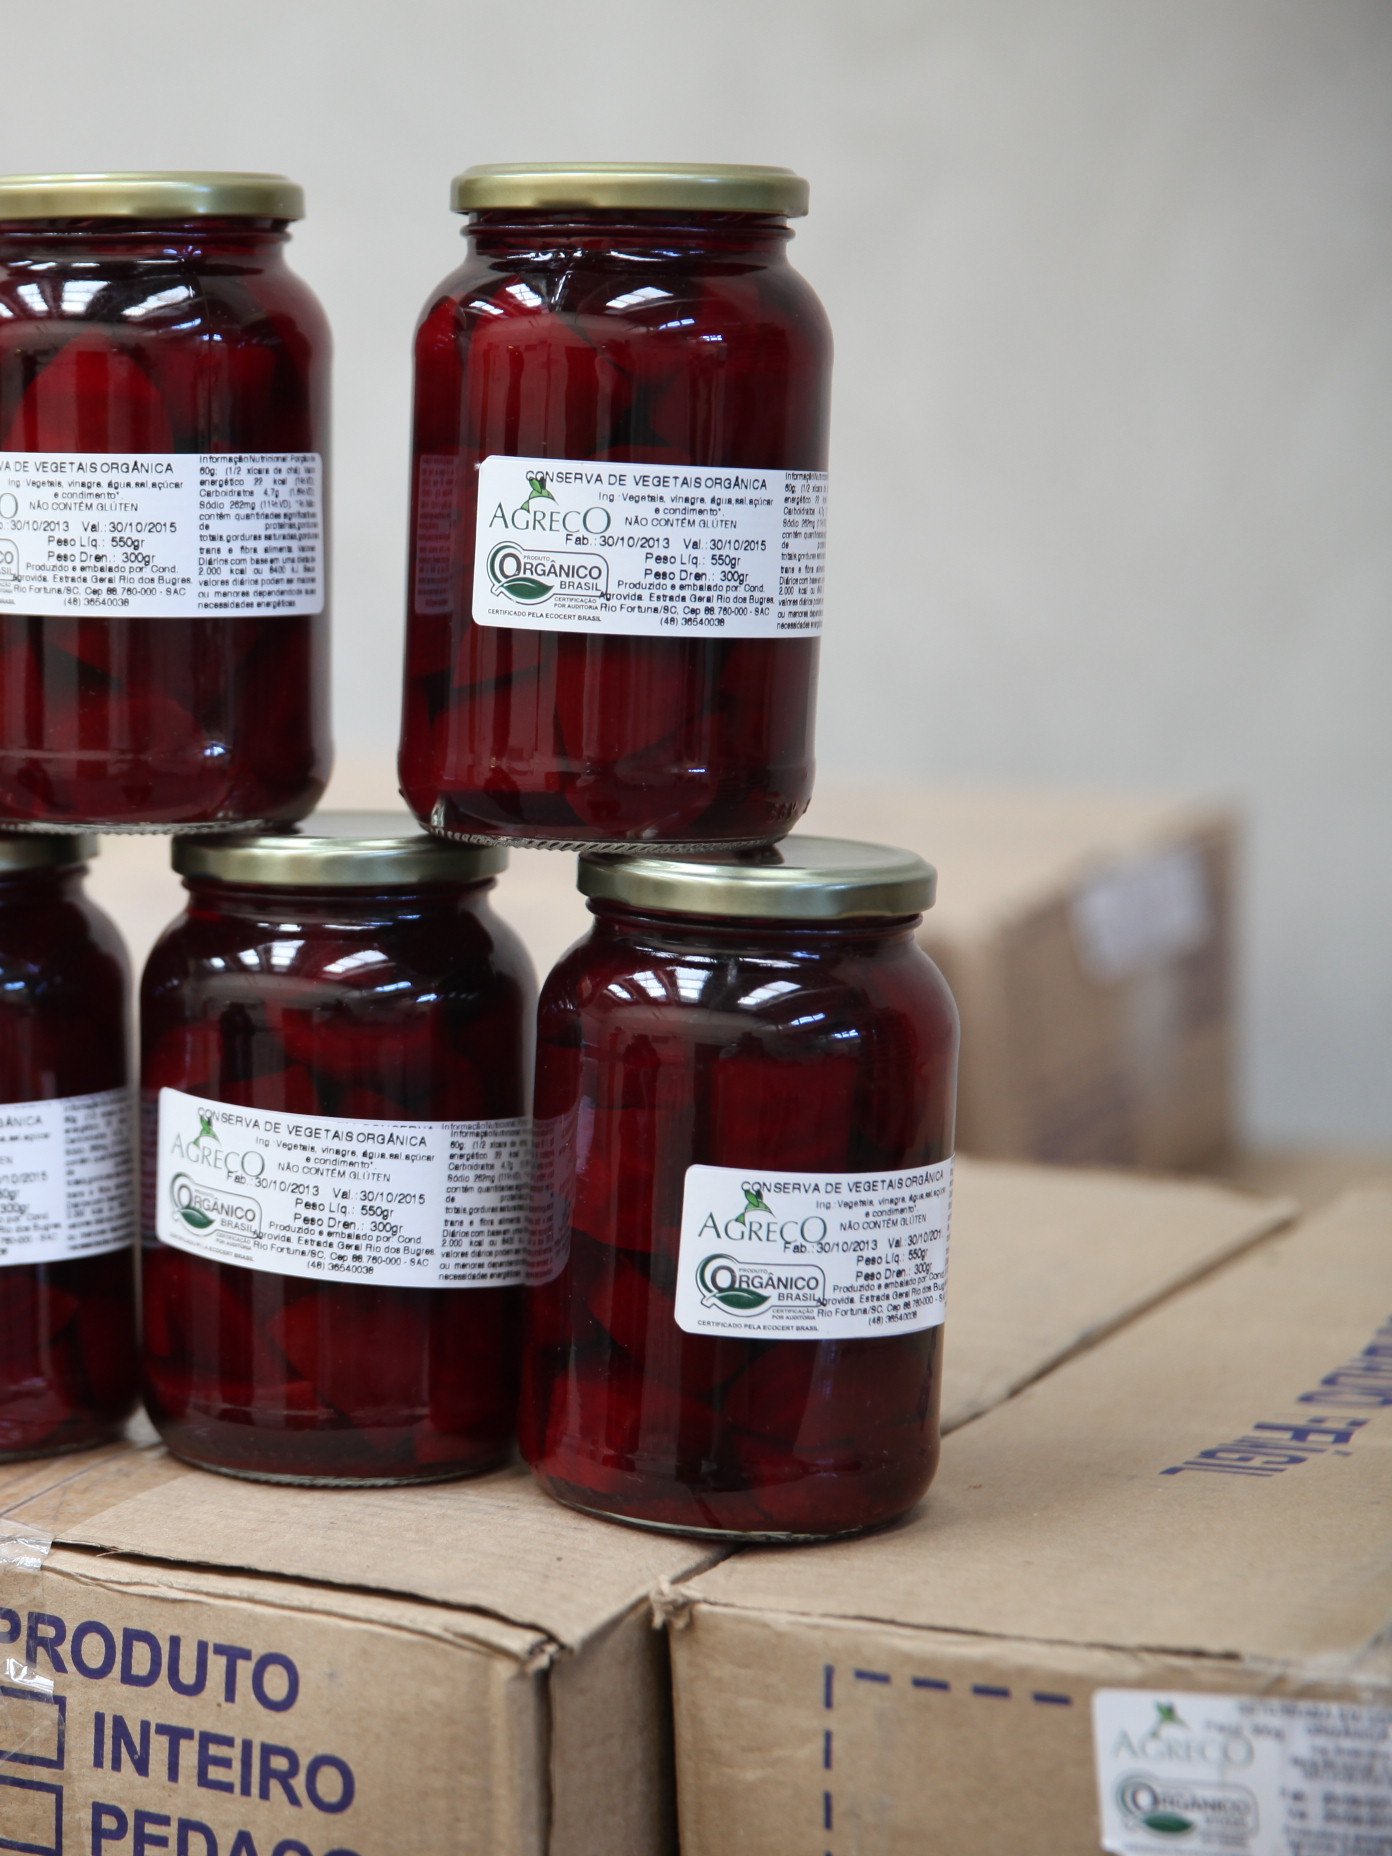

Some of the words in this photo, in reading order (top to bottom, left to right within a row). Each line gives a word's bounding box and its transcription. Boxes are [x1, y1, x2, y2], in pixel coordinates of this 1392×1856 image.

[14, 461, 29, 472] DE
[34, 461, 97, 473] VEGETAIS
[100, 460, 174, 474] ORGÂNICA
[525, 470, 603, 485] CONSERVA
[608, 474, 627, 486] DE
[633, 475, 702, 488] VEGETAIS
[705, 475, 767, 490] ORGÂNICA
[29, 500, 49, 510] NÃO
[52, 501, 93, 512] CONTÉM
[96, 501, 138, 512] GLÚTEN
[489, 501, 611, 534] AGRECO
[625, 515, 648, 526] NÃO
[651, 516, 696, 528] CONTÉM
[698, 518, 737, 529] GLÚTEN
[48, 535, 76, 547] Peso
[111, 536, 145, 550] 550gr
[47, 550, 76, 562] Peso
[121, 552, 156, 566] 300gr
[498, 552, 602, 580] ORGÂNICO
[644, 552, 676, 565] Peso
[711, 554, 741, 568] 550gr
[26, 562, 69, 572] Produzido
[80, 563, 126, 572] embalado
[53, 575, 87, 584] Estrada
[91, 575, 115, 584] Geral
[119, 575, 135, 584] Rio
[644, 568, 676, 581] Peso
[720, 571, 749, 585] 300gr
[559, 581, 601, 591] BRASIL
[617, 580, 668, 591] Produzido
[679, 581, 724, 592] embalado
[649, 593, 687, 603] Estrada
[689, 594, 714, 603] Geral
[716, 594, 731, 604] Rio
[732, 595, 747, 604] dos
[488, 608, 527, 617] CERTIFICADO
[577, 614, 602, 622] BRASIL
[600, 603, 617, 613] Rio
[682, 606, 701, 617] Cep
[754, 607, 770, 616] SAC
[198, 1106, 260, 1130] CONSERVA
[264, 1121, 281, 1133] DE
[287, 1124, 354, 1142] VEGETAIS
[356, 1132, 427, 1147] ORGÂNICA
[170, 1132, 265, 1177] AGRECO
[278, 1162, 299, 1173] NÃO
[302, 1165, 346, 1179] CONTÉM
[349, 1170, 391, 1182] GLÚTEN
[741, 1181, 821, 1194] CONSERVA
[825, 1182, 842, 1194] DE
[847, 1178, 904, 1193] VEGETAIS
[295, 1197, 325, 1212] Peso
[361, 1204, 394, 1220] 550gr
[220, 1217, 255, 1232] BRASIL
[293, 1213, 324, 1226] Peso
[370, 1221, 404, 1236] 300gr
[698, 1211, 827, 1243] AGRECO
[840, 1220, 860, 1231] NÃO
[862, 1217, 898, 1230] CONTÉM
[900, 1214, 926, 1226] GLÚTEN
[268, 1221, 315, 1236] Produzido
[327, 1227, 375, 1242] embalado
[253, 1240, 268, 1251] Rio
[409, 1257, 430, 1267] SAC
[297, 1237, 334, 1249] Estrada
[337, 1241, 363, 1251] Geral
[365, 1243, 382, 1253] Rio
[384, 1244, 401, 1255] dos
[856, 1255, 883, 1266] Peso
[710, 1265, 819, 1292] ORGÂNICO
[856, 1271, 882, 1281] Peso
[833, 1283, 875, 1293] Produzido
[778, 1292, 818, 1302] BRASIL
[859, 1292, 890, 1304] Estrada
[892, 1290, 910, 1300] Geral
[817, 1309, 832, 1318] Rio
[697, 1320, 742, 1329] CERTIFICADO
[93, 1711, 355, 1814] INTEIRO
[91, 1801, 364, 1856] PED
